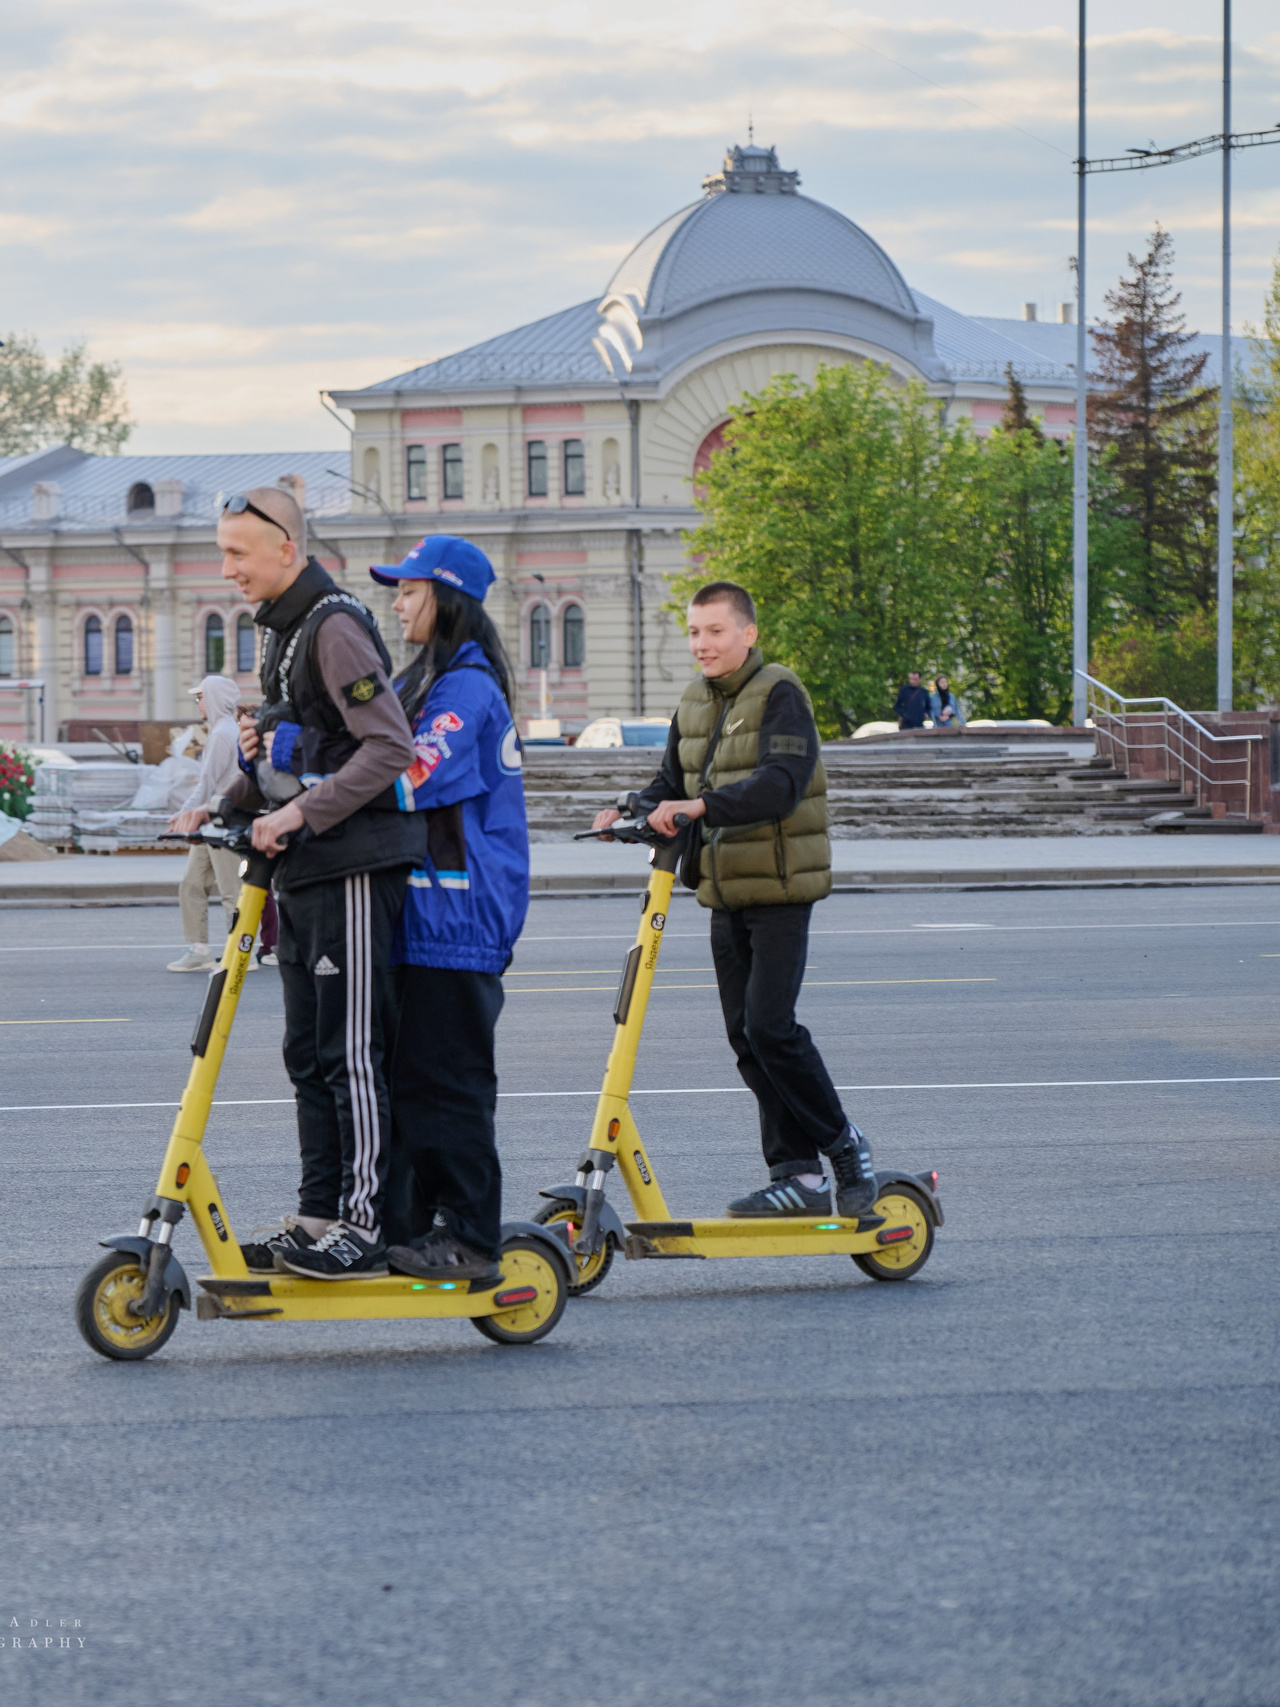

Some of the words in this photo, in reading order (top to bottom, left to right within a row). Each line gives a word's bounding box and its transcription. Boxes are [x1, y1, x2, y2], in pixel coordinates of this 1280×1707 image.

[651, 913, 665, 930] Go
[238, 934, 253, 952] Go
[644, 932, 662, 971] Яндекс
